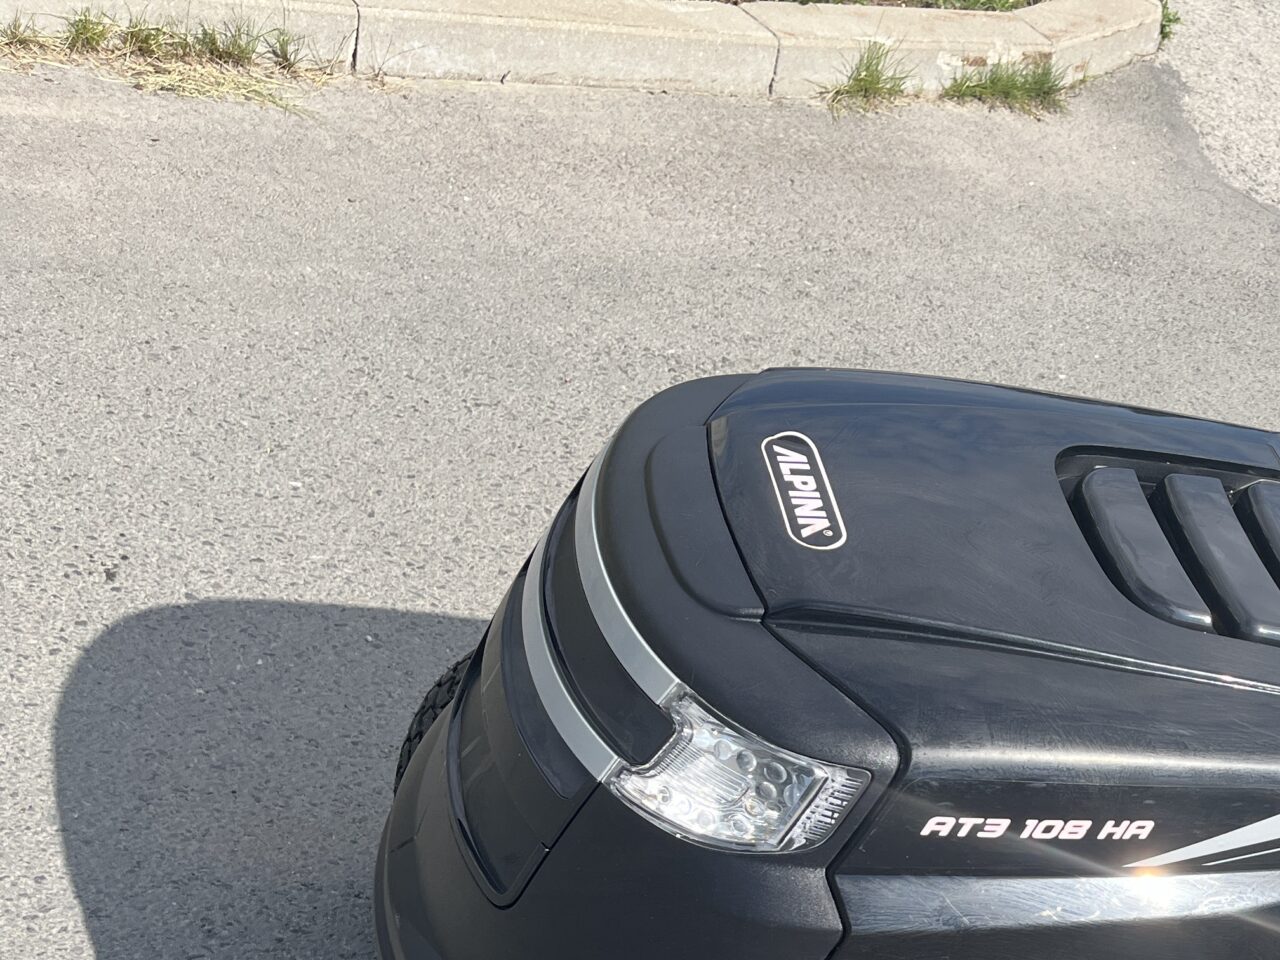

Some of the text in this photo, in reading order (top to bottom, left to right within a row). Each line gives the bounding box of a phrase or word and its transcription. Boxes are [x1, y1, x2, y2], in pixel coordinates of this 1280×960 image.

[772, 444, 831, 538] ALPINA
[919, 815, 1155, 840] AT3 108 HA
